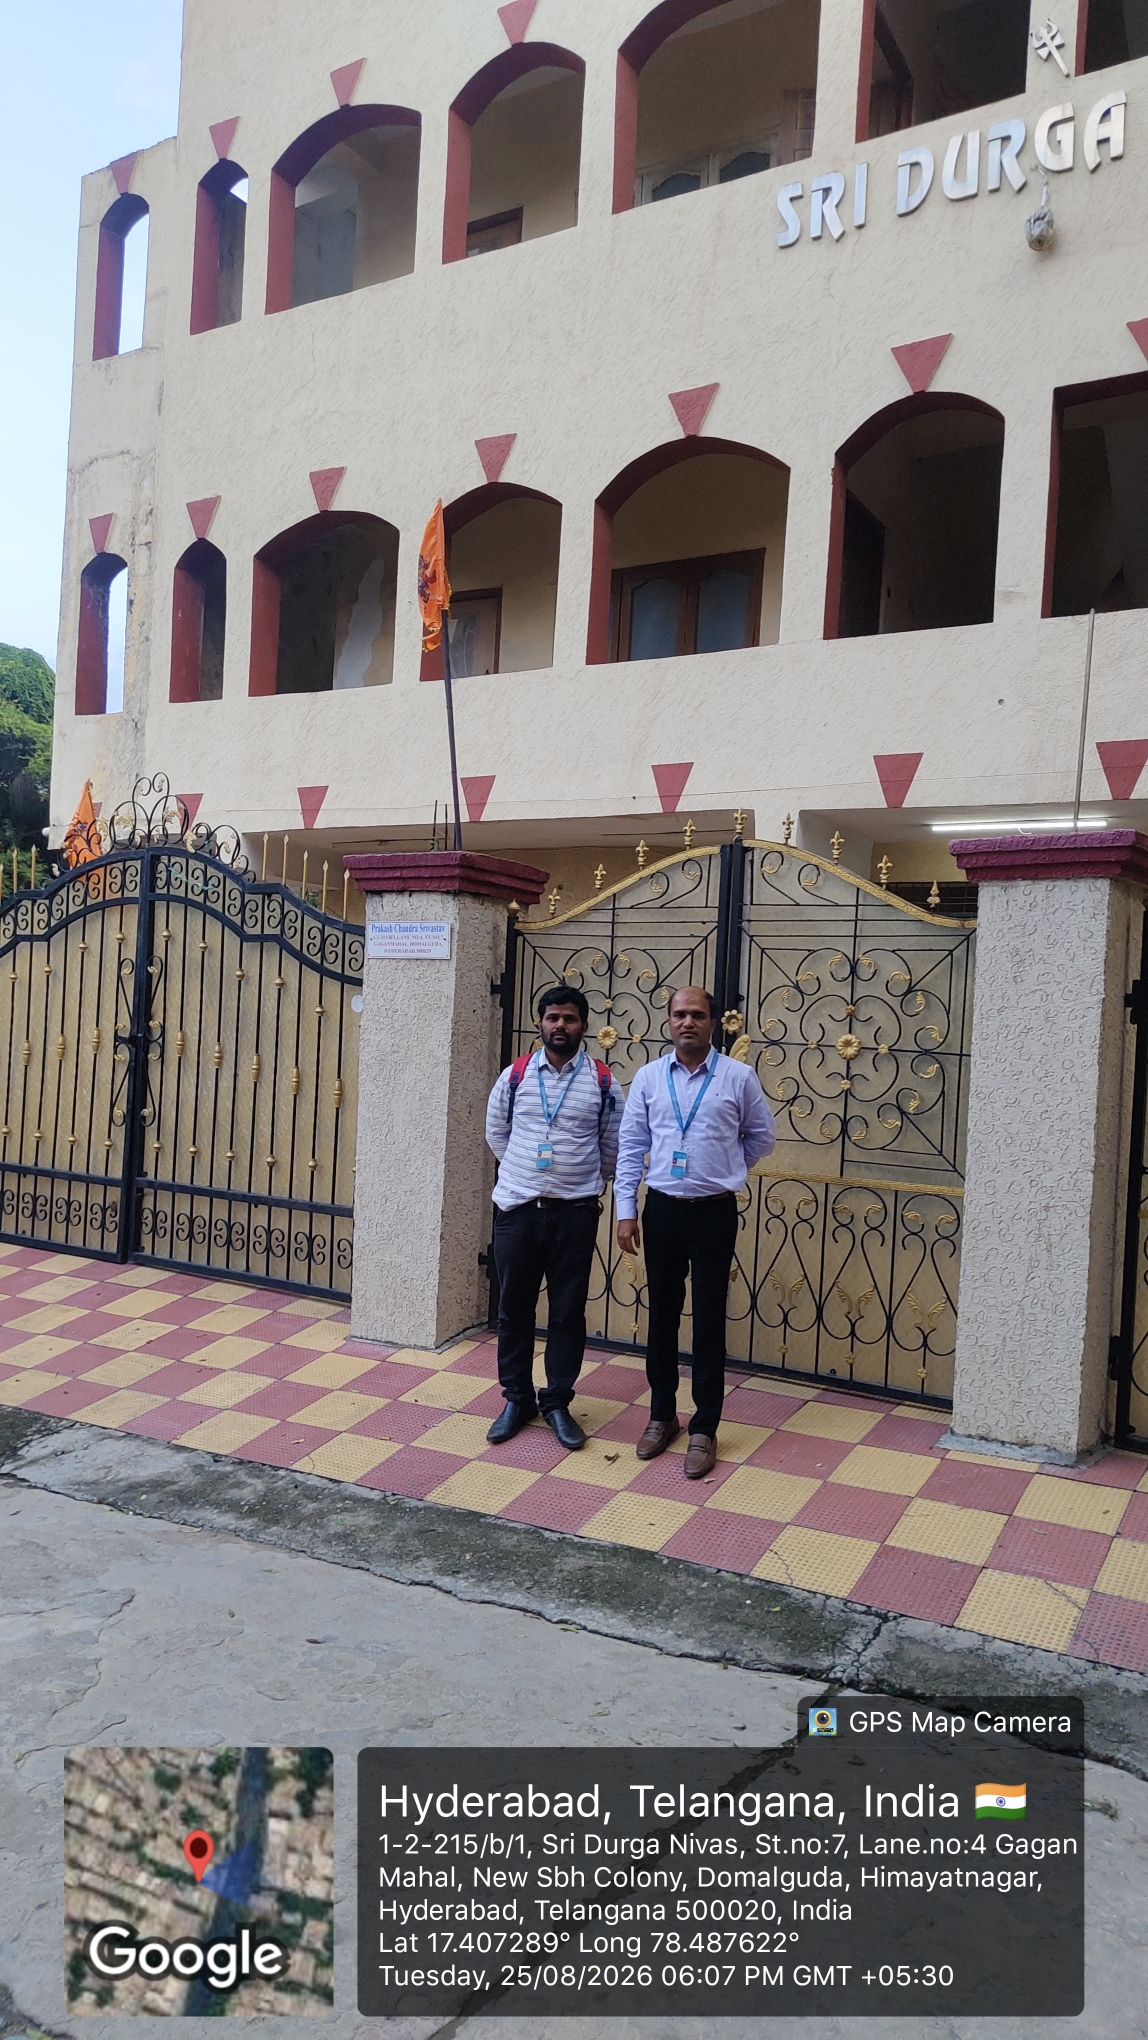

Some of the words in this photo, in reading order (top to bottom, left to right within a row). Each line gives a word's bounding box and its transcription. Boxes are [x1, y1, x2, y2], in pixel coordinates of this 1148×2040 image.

[775, 162, 869, 249] SRI
[896, 88, 1128, 217] DURGA
[372, 924, 393, 933] Prakash
[394, 924, 418, 933] Chandra
[420, 924, 445, 933] Srivastav
